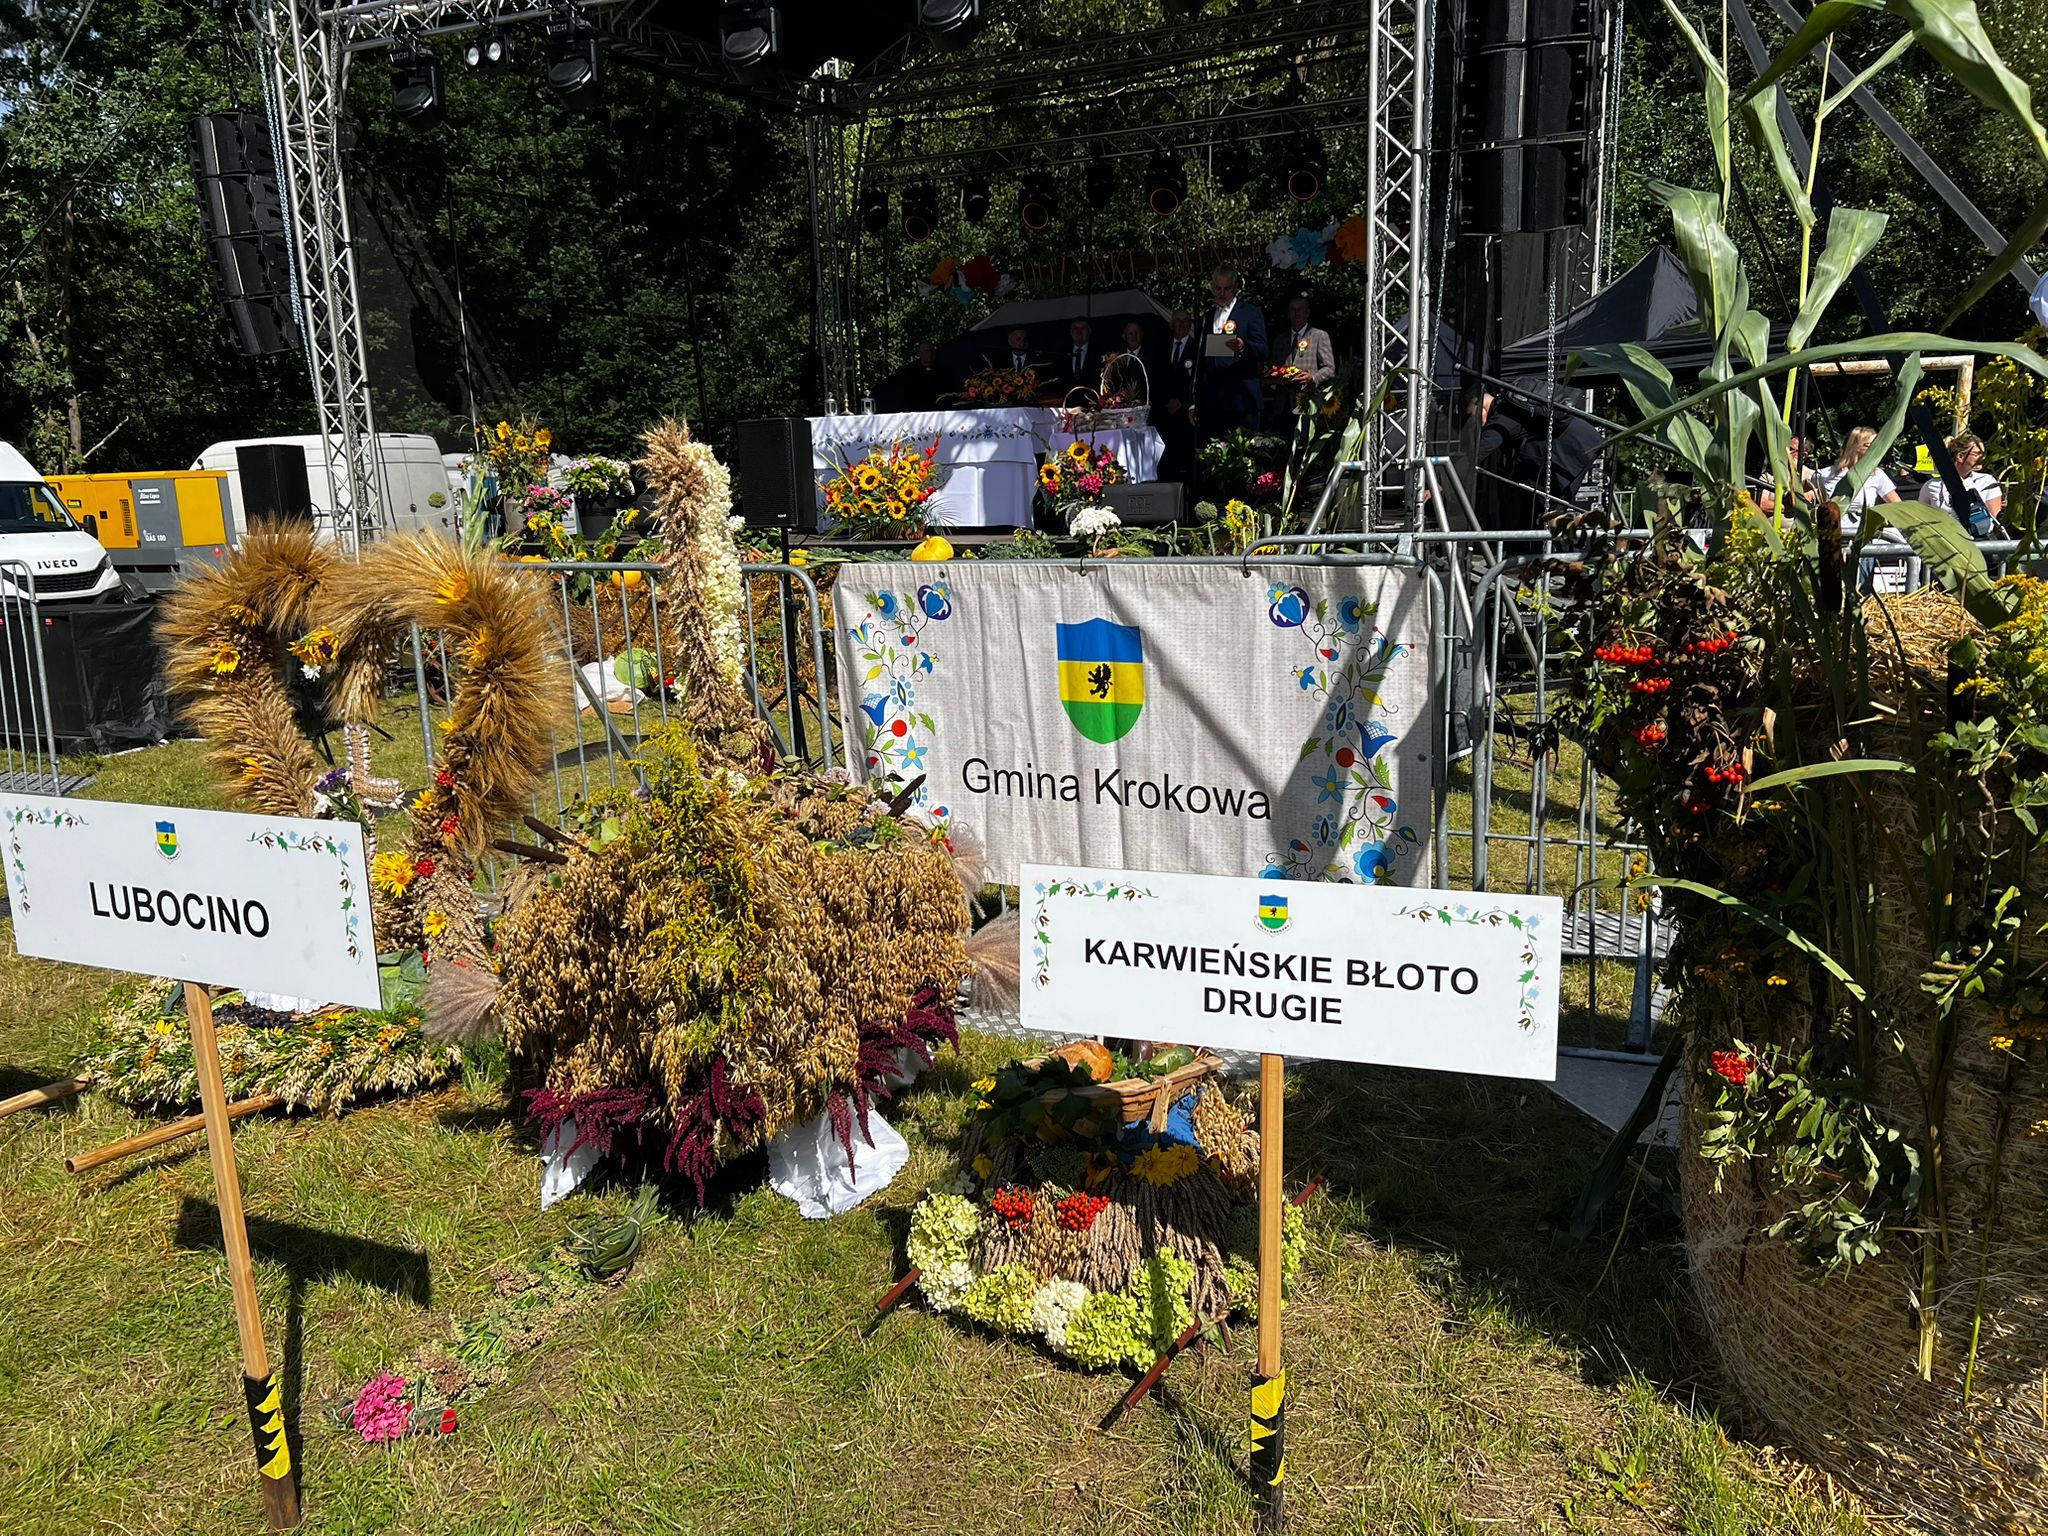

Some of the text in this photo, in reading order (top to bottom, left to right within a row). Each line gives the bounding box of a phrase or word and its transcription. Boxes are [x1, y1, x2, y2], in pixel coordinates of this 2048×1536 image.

[37, 558, 78, 570] IVECO
[962, 758, 1272, 820] Gmina Krokowa
[89, 881, 270, 938] LUBOCINO
[1084, 939, 1479, 995] KARWIEŃSKIE BŁOTO
[1203, 986, 1343, 1025] DRUGIE
